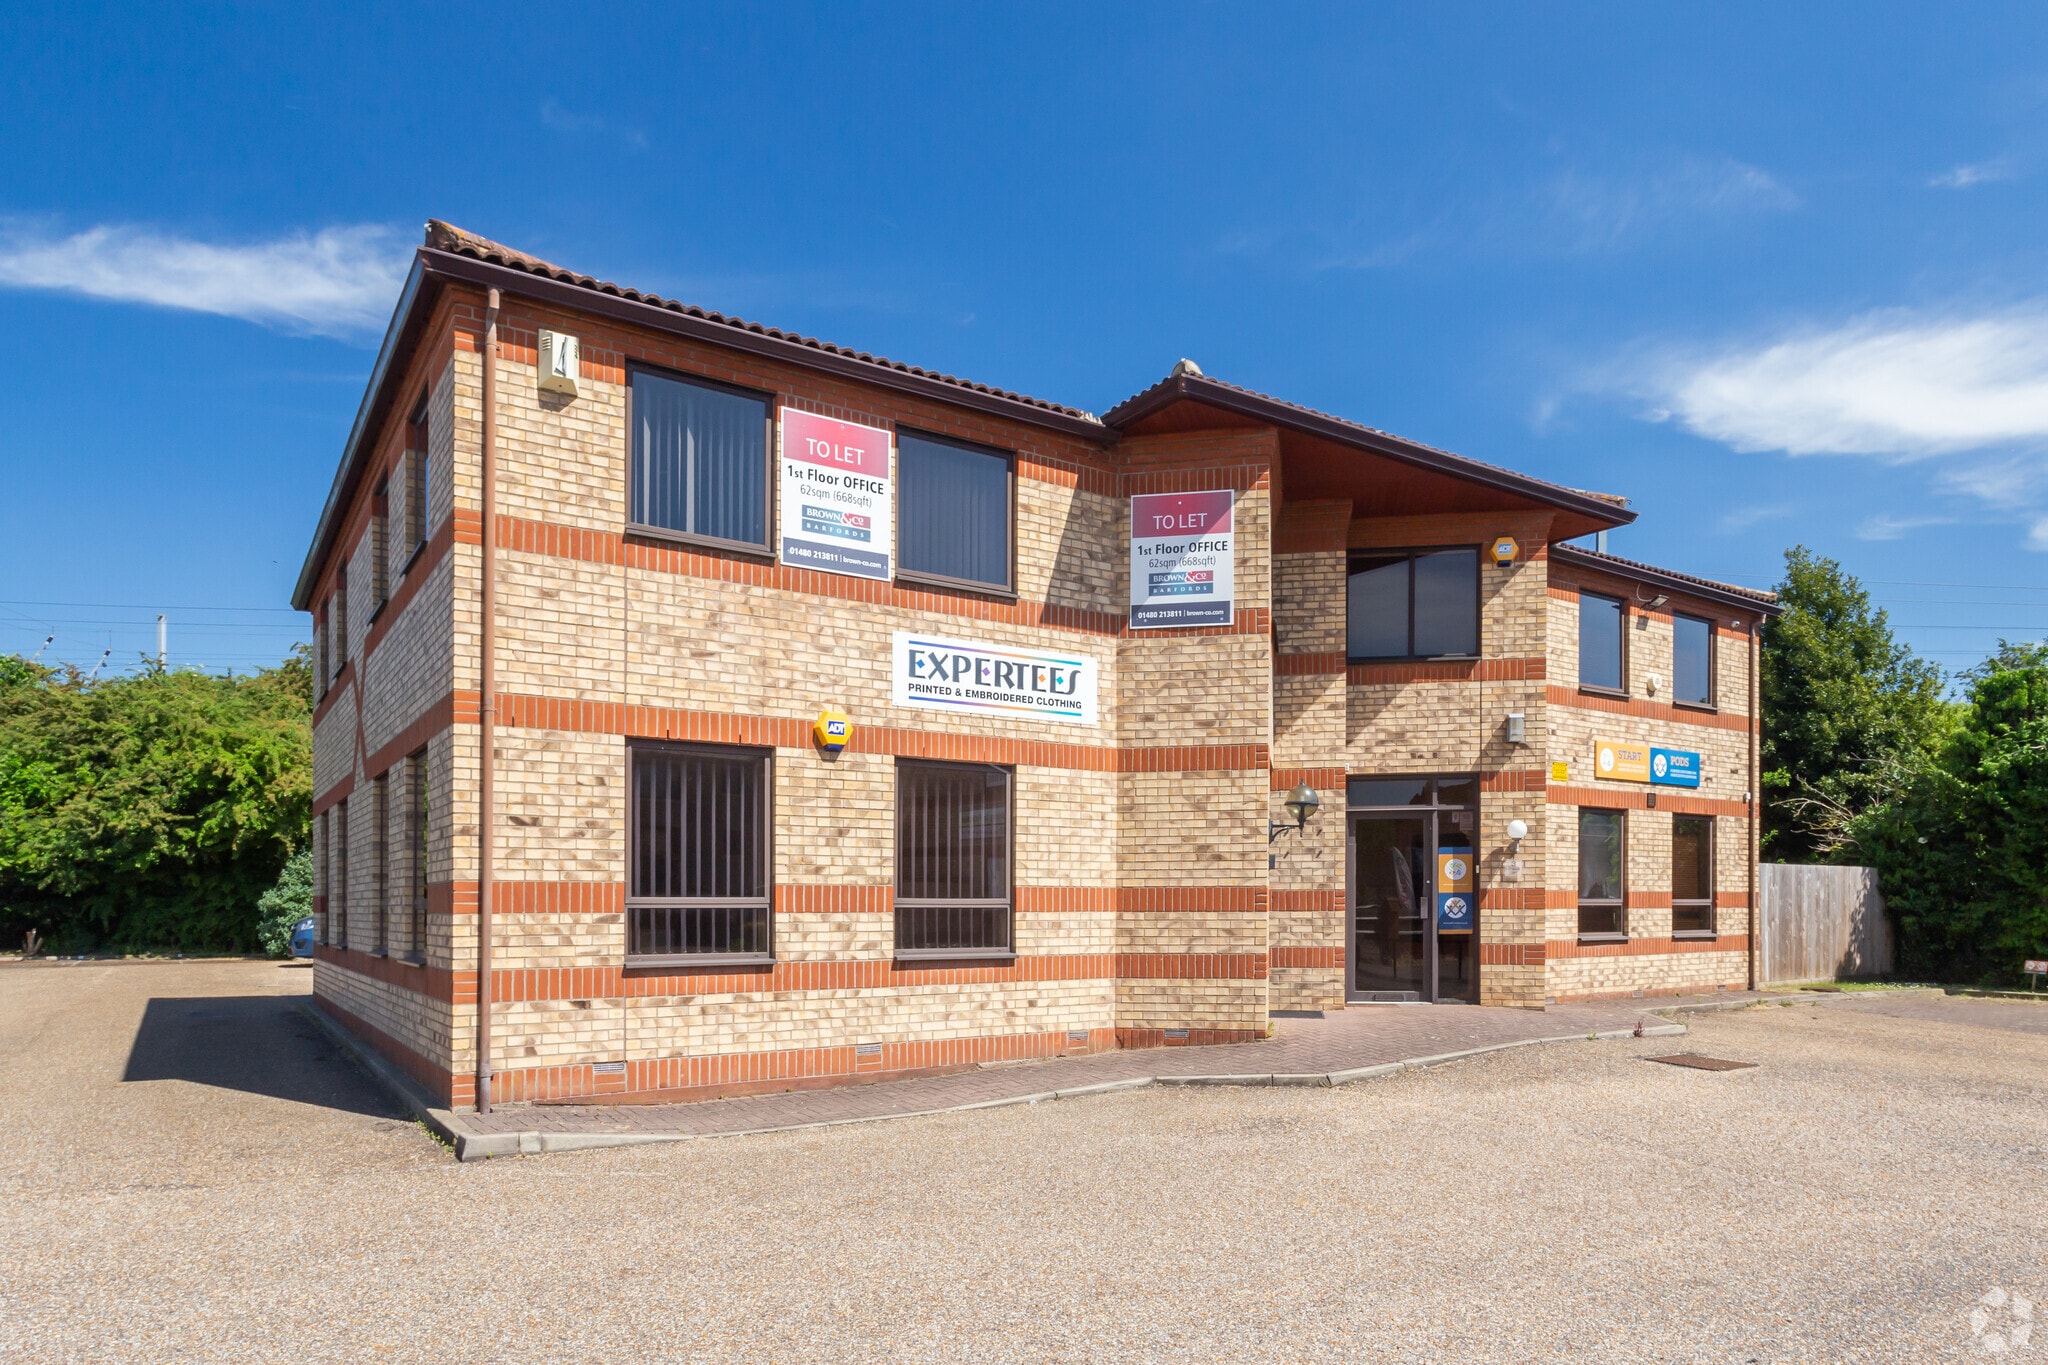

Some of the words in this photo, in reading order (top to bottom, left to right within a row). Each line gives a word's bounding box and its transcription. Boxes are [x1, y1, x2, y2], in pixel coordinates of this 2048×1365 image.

[806, 437, 830, 458] TO
[834, 444, 865, 465] LET
[787, 465, 803, 479] 1st
[807, 468, 840, 486] Floor
[843, 476, 884, 495] OFFICE
[800, 483, 831, 500] 62sqm
[833, 490, 872, 509] (668sqft)
[1153, 514, 1175, 530] TO
[1179, 512, 1208, 529] LET
[806, 522, 865, 538] BARFORDS
[789, 546, 812, 557] 01480
[813, 550, 838, 562] 213811
[1137, 545, 1152, 556] 1st
[1155, 543, 1185, 555] Floor
[1188, 540, 1228, 553] OFFICE
[1149, 558, 1177, 571] 62sqm
[1179, 555, 1216, 568] (668sqft)
[1153, 585, 1207, 593] BARFORDS
[1138, 611, 1158, 619] 01480
[1158, 610, 1182, 618] 213811
[908, 649, 1082, 695] EXPERTEES
[908, 683, 952, 696] PRINTED
[955, 687, 962, 697] &
[965, 688, 1034, 704] EMBROIDERED
[1036, 696, 1082, 710] CLOTHING
[828, 722, 844, 734] ADT
[1618, 750, 1642, 761] START
[1670, 755, 1689, 767] PODS
